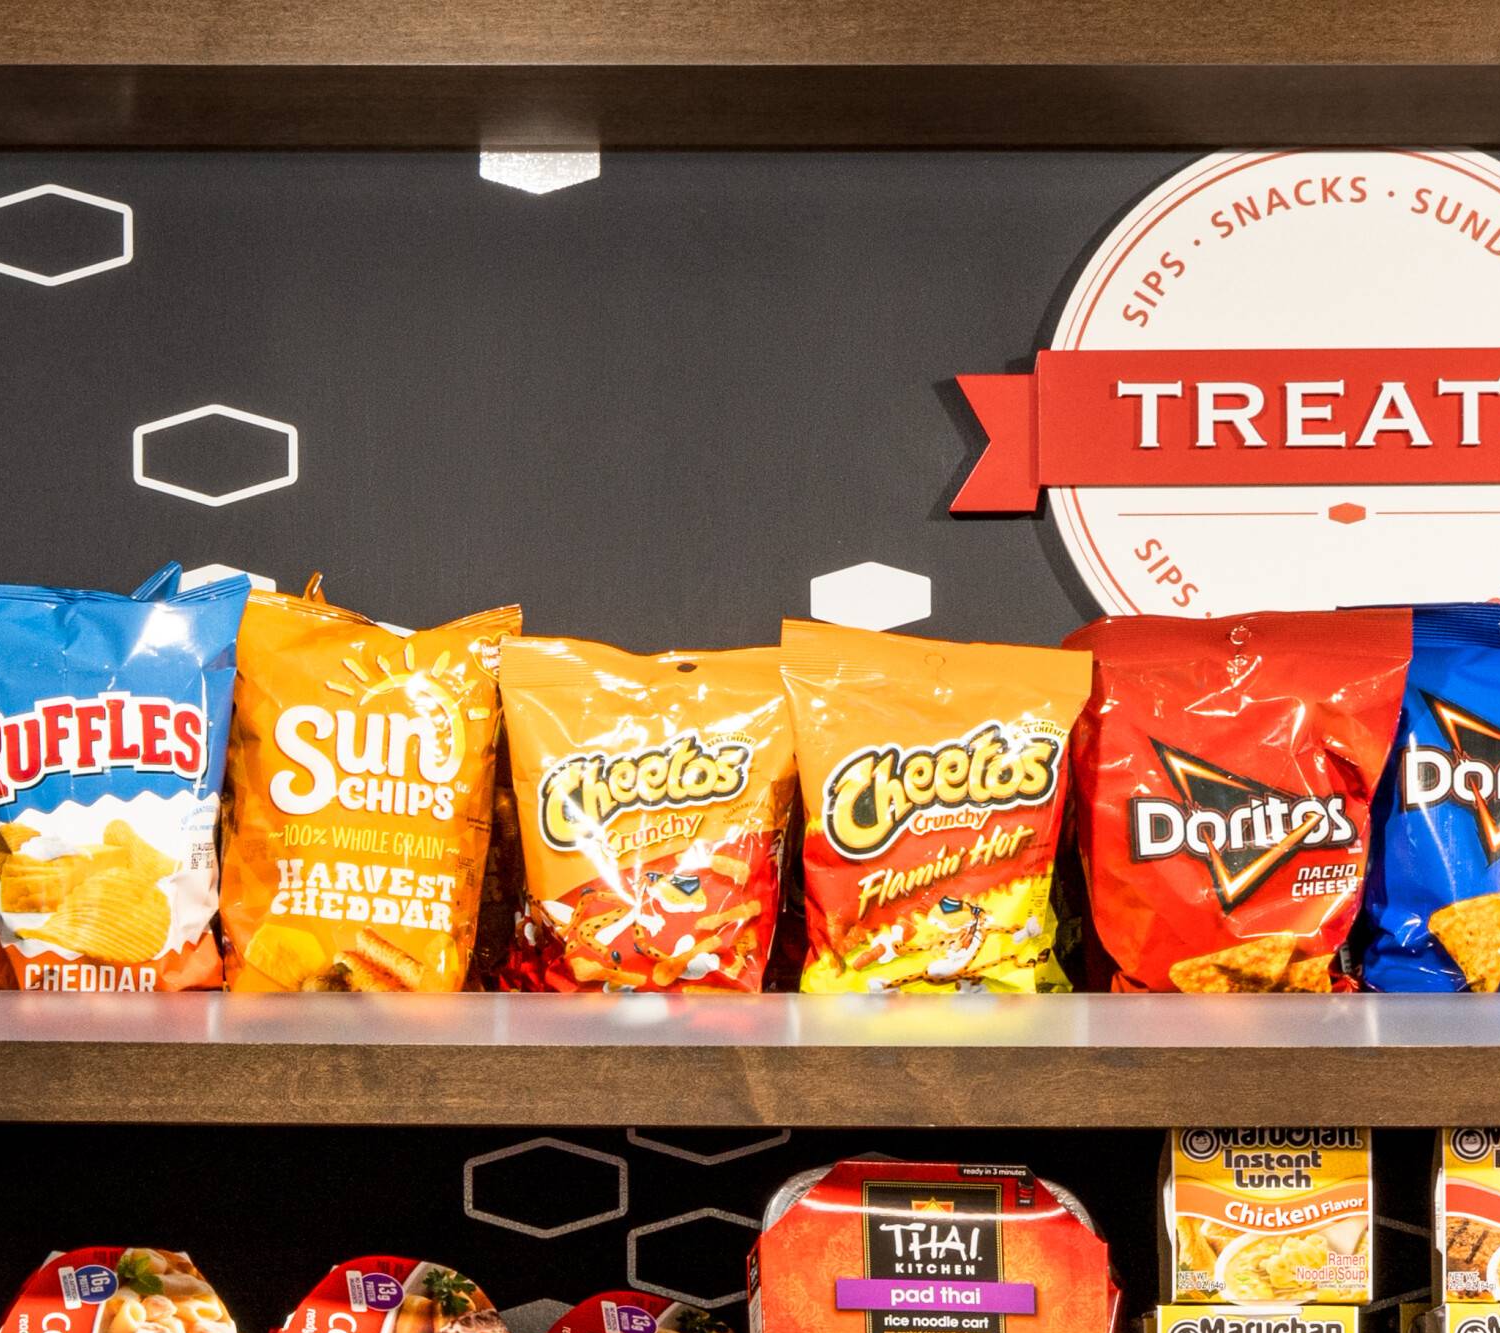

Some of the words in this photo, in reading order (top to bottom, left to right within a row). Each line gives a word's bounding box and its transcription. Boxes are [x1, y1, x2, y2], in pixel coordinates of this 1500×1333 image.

[1123, 252, 1185, 328] SIPS
[1210, 176, 1369, 239] SNACKS
[1135, 538, 1199, 608] SIPS
[269, 704, 464, 815] Sun
[338, 776, 455, 821] CHIPS
[542, 736, 748, 845] Cheetos
[828, 728, 1058, 851] Cheetos
[606, 812, 702, 853] Crunchy
[912, 810, 988, 833] Crunchy
[1137, 797, 1355, 858] Doritos
[283, 824, 327, 847] 100%
[332, 826, 388, 854] WHOLE
[395, 831, 445, 860] GRAIN
[276, 859, 456, 902] HARVEST
[858, 844, 964, 918] Flamin'
[968, 825, 1034, 866] Hot
[270, 887, 453, 932] CHEDDAR
[1224, 1150, 1322, 1170] Instant
[1235, 1170, 1312, 1189] Lunch
[1225, 1201, 1320, 1228] Chicken
[1321, 1198, 1365, 1215] Flavor
[879, 1223, 980, 1261] THAI
[1328, 1253, 1366, 1266] Ramen
[90, 1272, 111, 1293] 16g
[895, 1263, 976, 1275] KITCHEN
[1296, 1268, 1335, 1280] Noodle
[1338, 1268, 1366, 1282] Soup
[891, 1287, 934, 1306] pad
[940, 1287, 981, 1305] thai
[884, 1315, 909, 1326] rice
[912, 1316, 958, 1328] noodle
[962, 1317, 989, 1329] cart
